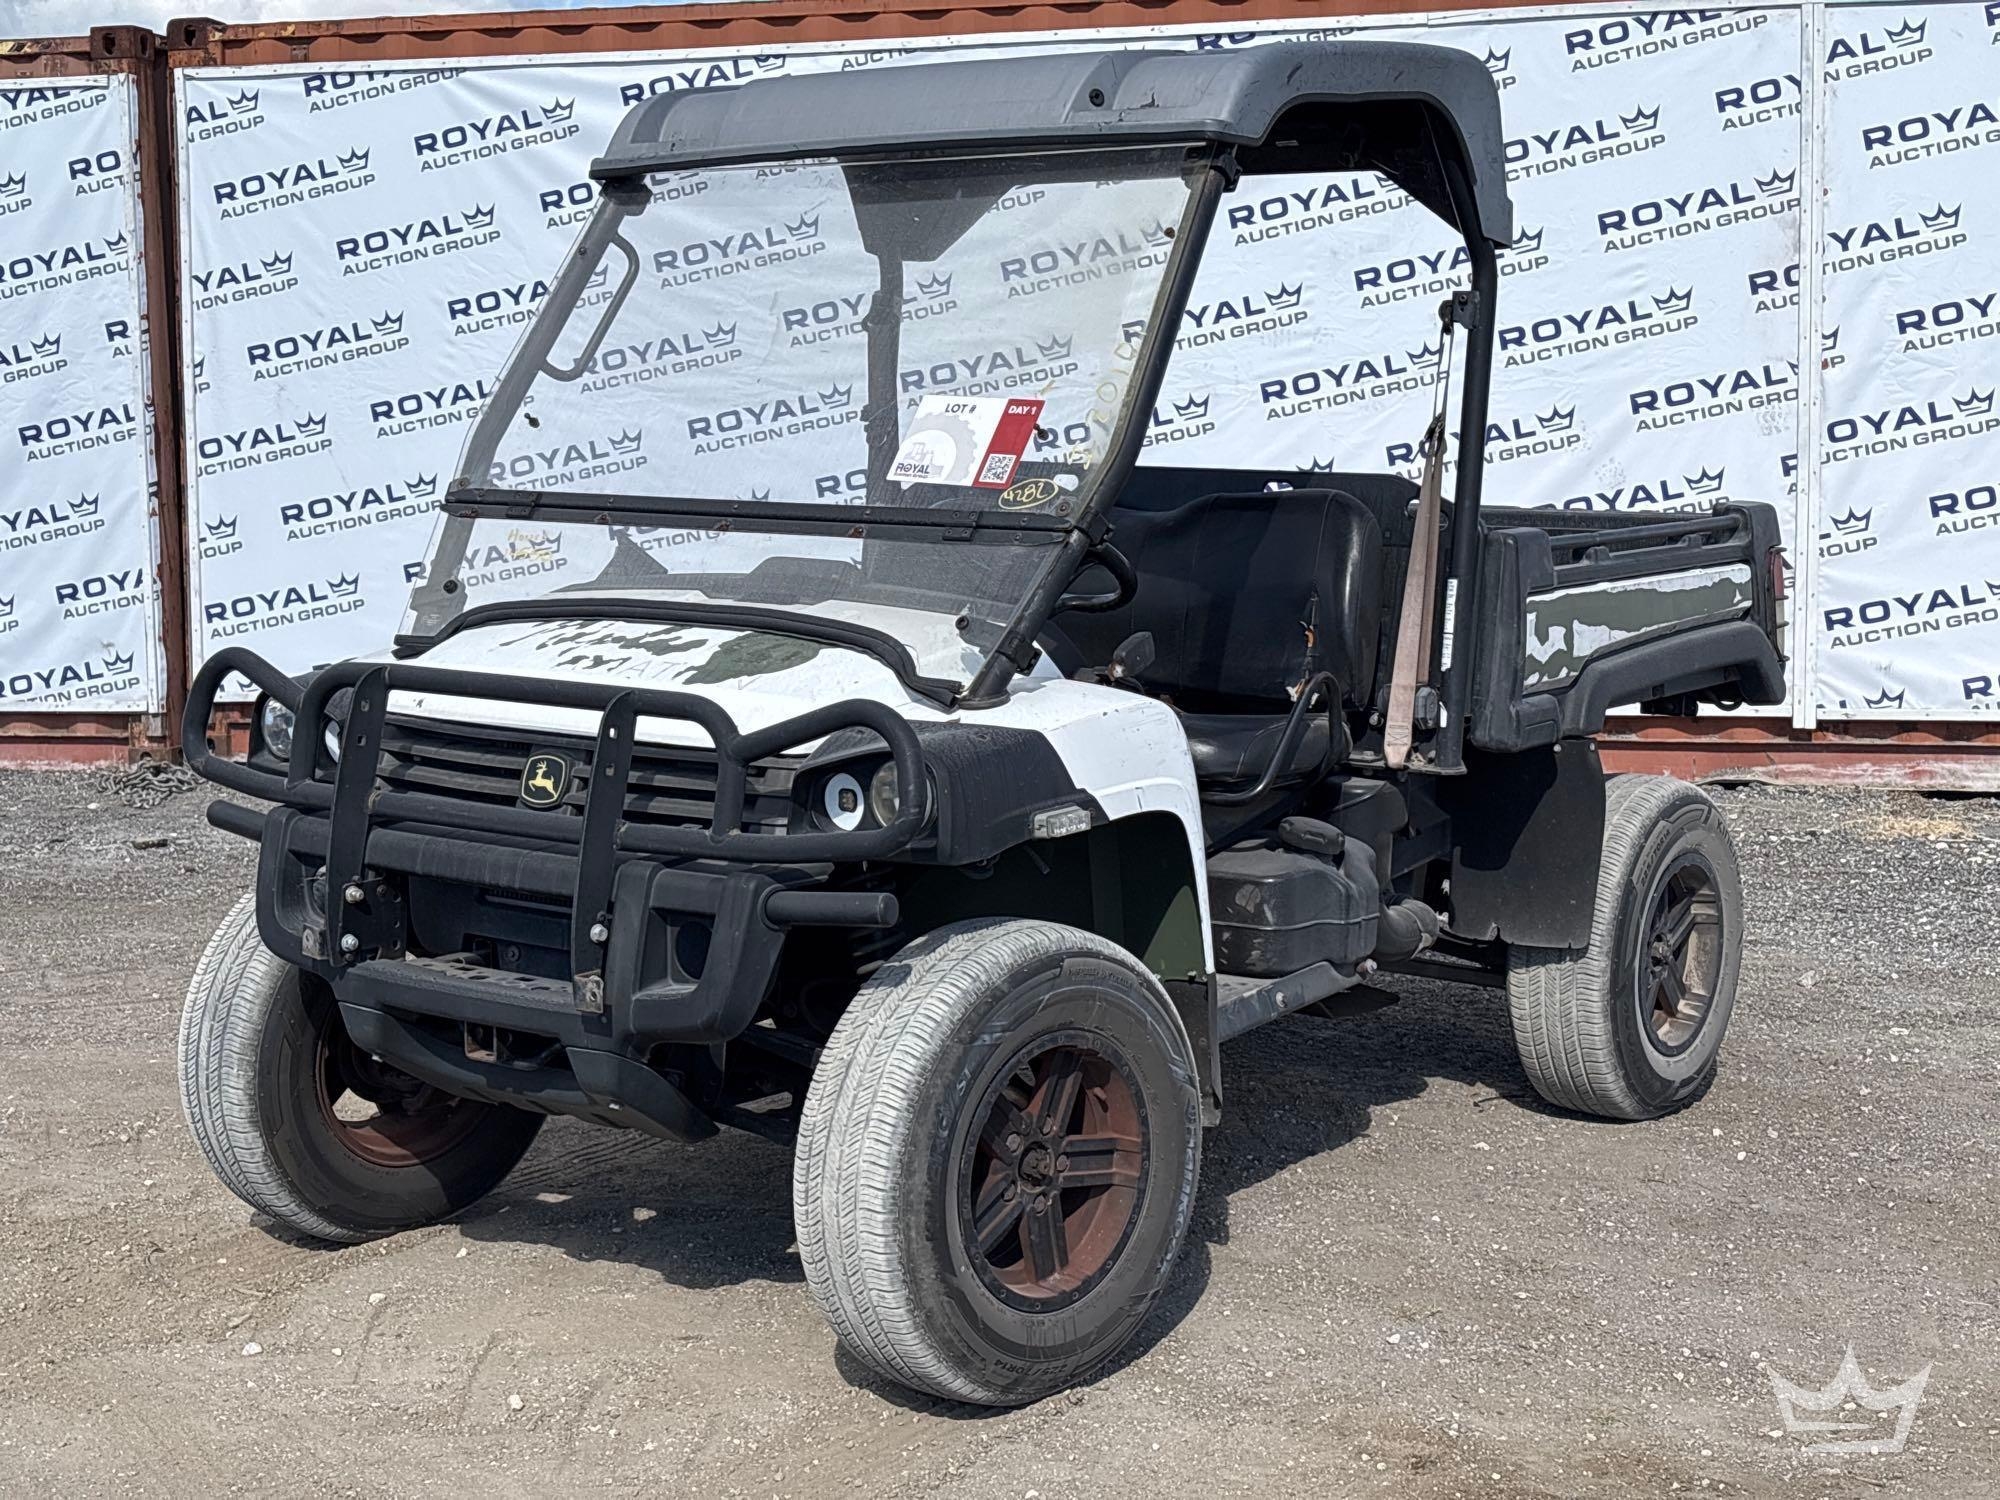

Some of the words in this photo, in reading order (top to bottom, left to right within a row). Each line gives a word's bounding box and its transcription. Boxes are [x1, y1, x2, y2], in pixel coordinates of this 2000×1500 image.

[1572, 36, 1677, 72] AUCTION
[1683, 15, 1767, 45] GROUP
[1846, 48, 1932, 78] GROUP
[0, 87, 70, 110] YAL
[41, 94, 106, 119] GROUP
[310, 83, 395, 113] AUCTION
[199, 115, 264, 140] GROUP
[414, 110, 542, 156] ROYAL
[1504, 120, 1620, 163] OYAL
[1862, 103, 1999, 151] ROYA
[421, 142, 507, 172] AUCTION
[511, 124, 579, 149] GROUP
[1506, 155, 1576, 182] CTION
[1582, 135, 1665, 163] GROUP
[1870, 134, 1980, 169] AUCTION
[214, 158, 338, 204] ROYAL
[221, 191, 304, 220] AUCTION
[308, 174, 375, 198] GROUP
[651, 181, 708, 204] ROUP
[987, 190, 1045, 213] ROUP
[1228, 179, 1373, 229] ROYAL
[1598, 183, 1755, 235] ROYAL
[336, 215, 464, 260] ROYAL
[1235, 213, 1334, 247] AUCTION
[1604, 218, 1711, 253] AUCTION
[1716, 198, 1800, 228] GROUP
[1827, 218, 1920, 252] YAL
[0, 242, 106, 283] OYAL
[343, 247, 428, 276] AUCTION
[432, 231, 500, 255] GROUP
[653, 225, 785, 273] ROYAL
[661, 259, 750, 289] AUCTION
[755, 242, 825, 267] GROUP
[1000, 234, 1141, 282] ROYAL
[1880, 233, 1967, 262] GROUP
[0, 273, 72, 299] UCTION
[76, 260, 128, 281] GROU
[192, 263, 262, 292] YAL
[1008, 266, 1102, 299] AUCTION
[1106, 251, 1168, 276] GROU
[1354, 246, 1470, 290] ROYA
[232, 277, 298, 301] GROUP
[448, 280, 550, 320] ROYA
[575, 290, 614, 309] OUP
[1361, 276, 1462, 309] AUCTION
[790, 321, 864, 348] AUCTIO
[902, 300, 957, 322] ROUP
[1175, 330, 1226, 352] TION
[1230, 311, 1307, 338] GROUP
[1498, 300, 1653, 351] ROYAL
[1896, 293, 1998, 334] ROY
[247, 322, 372, 365] ROYAL
[1505, 335, 1609, 368] AUCTION
[1614, 316, 1698, 343] GROUP
[1903, 322, 2000, 353] AUCTIO
[4, 359, 67, 383] GROUP
[254, 353, 338, 381] AUCTION
[342, 337, 409, 361] GROUP
[581, 365, 668, 394] AUCTION
[672, 349, 742, 373] GROUP
[900, 348, 1038, 393] ROYAL
[1004, 363, 1078, 388] GROUP
[1260, 356, 1408, 403] ROYAL
[1267, 389, 1366, 420] AUCTION
[1369, 370, 1449, 398] GROUP
[1630, 365, 1788, 415] ROYAL
[370, 380, 492, 422] ROYAL
[687, 395, 820, 439] ROYAL
[945, 404, 966, 414] LOT
[1008, 406, 1029, 414] DAY
[1031, 407, 1038, 415] 1
[1636, 400, 1743, 432] AUCTION
[1748, 388, 1798, 408] GRO
[18, 404, 135, 446] ROYAL
[198, 424, 296, 458] OYAL
[377, 410, 462, 438] AUCTION
[695, 427, 783, 455] AUCTION
[788, 410, 859, 434] GROUP
[1827, 402, 1954, 443] OYAL
[1913, 418, 2000, 446] GROUP
[27, 434, 109, 462] AUCTION
[266, 439, 332, 462] GROUP
[579, 456, 647, 479] GROUP
[1499, 434, 1580, 461] GROUP
[896, 462, 930, 474] ROYAL
[281, 484, 406, 525] ROYAL
[1562, 480, 1684, 512] OYAL
[0, 504, 70, 532] YAL
[41, 519, 105, 541] GROUP
[287, 514, 371, 541] AUCTION
[376, 500, 442, 523] GROUP
[1936, 514, 2000, 536] AUCT
[200, 540, 243, 560] OUP
[499, 558, 567, 581] GROUP
[63, 592, 144, 620] AUCTION
[205, 586, 330, 623] ROYAL
[211, 613, 294, 639] AUCTION
[298, 599, 364, 621] GROUP
[1825, 584, 1986, 631] ROYAL
[1831, 619, 1940, 649] AUCTION
[1946, 608, 1998, 628] GRO
[0, 662, 104, 698] OYAL
[76, 677, 140, 698] GROUP
